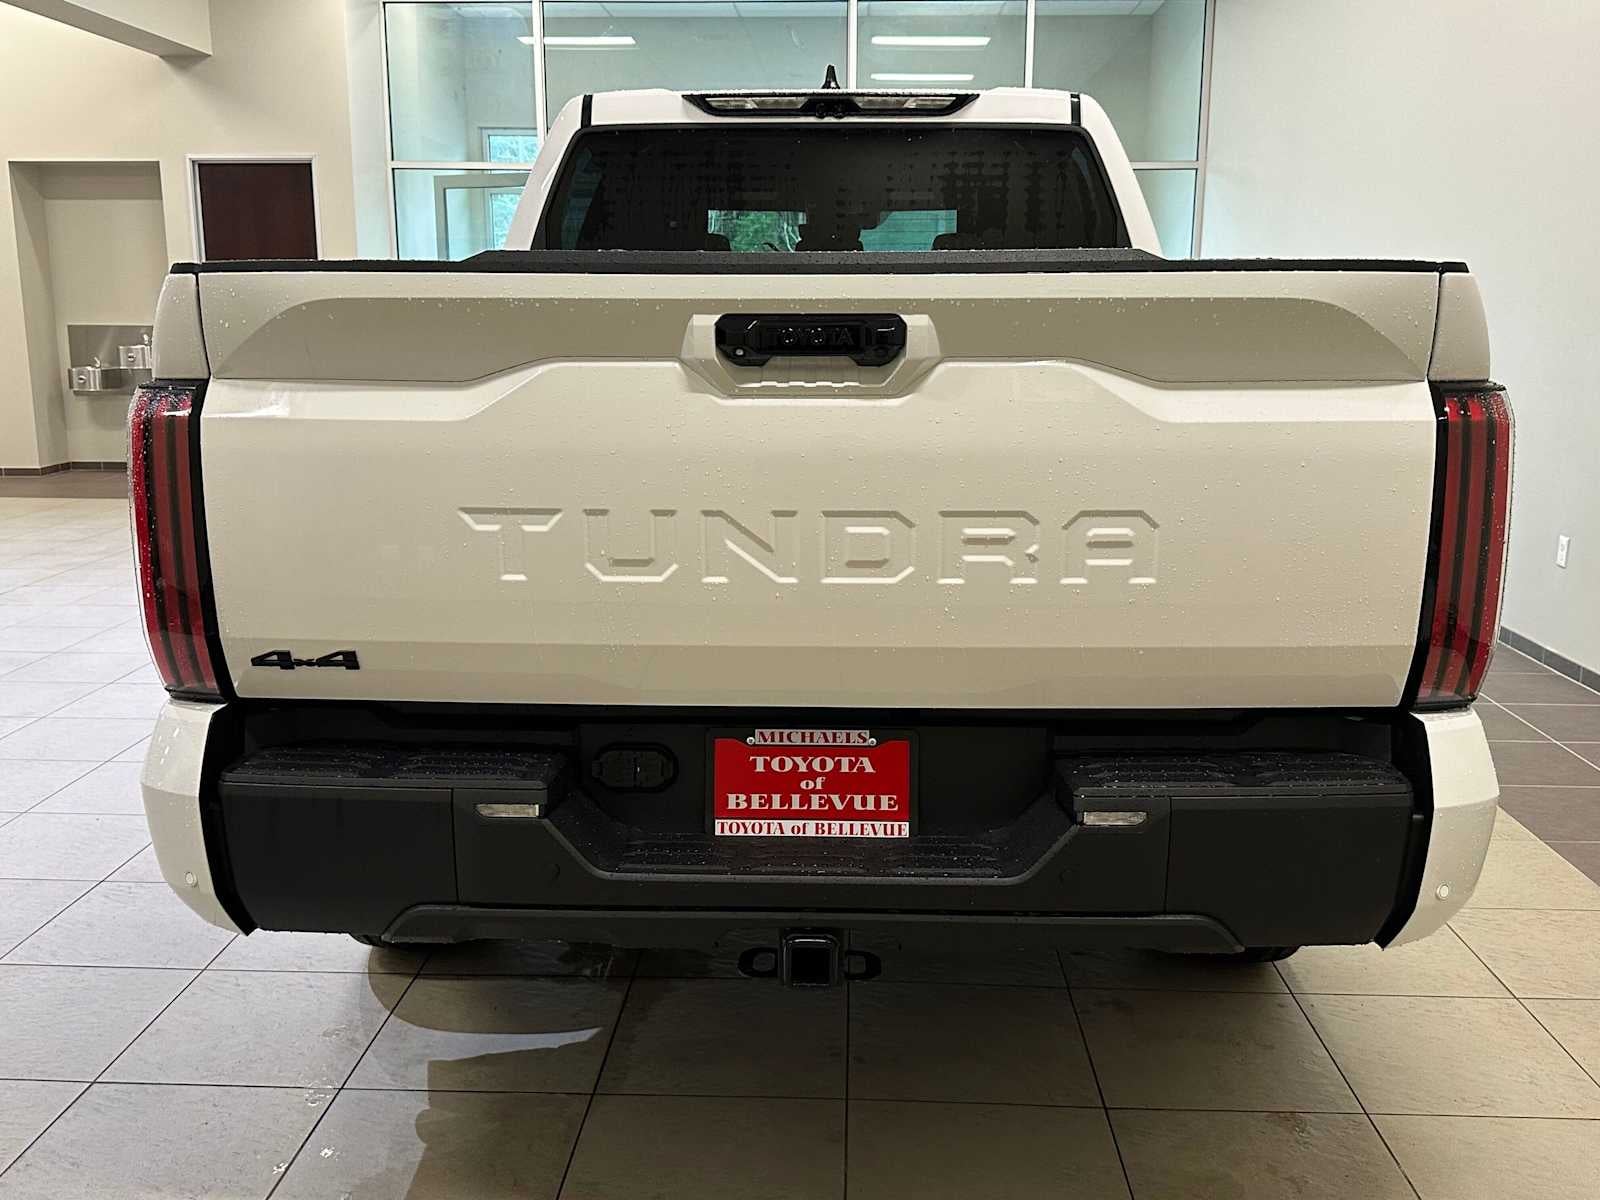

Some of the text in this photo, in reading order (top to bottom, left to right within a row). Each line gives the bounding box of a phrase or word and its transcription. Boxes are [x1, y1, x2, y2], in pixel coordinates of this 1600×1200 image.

[769, 327, 855, 345] OYOTA
[458, 506, 1160, 585] TUNDRA
[757, 730, 868, 745] MICHAELS
[749, 755, 876, 774] TOYOTA
[799, 776, 826, 790] of
[726, 793, 899, 811] BELLEVUE
[716, 820, 908, 837] TOYOTA of BELLEVUE
